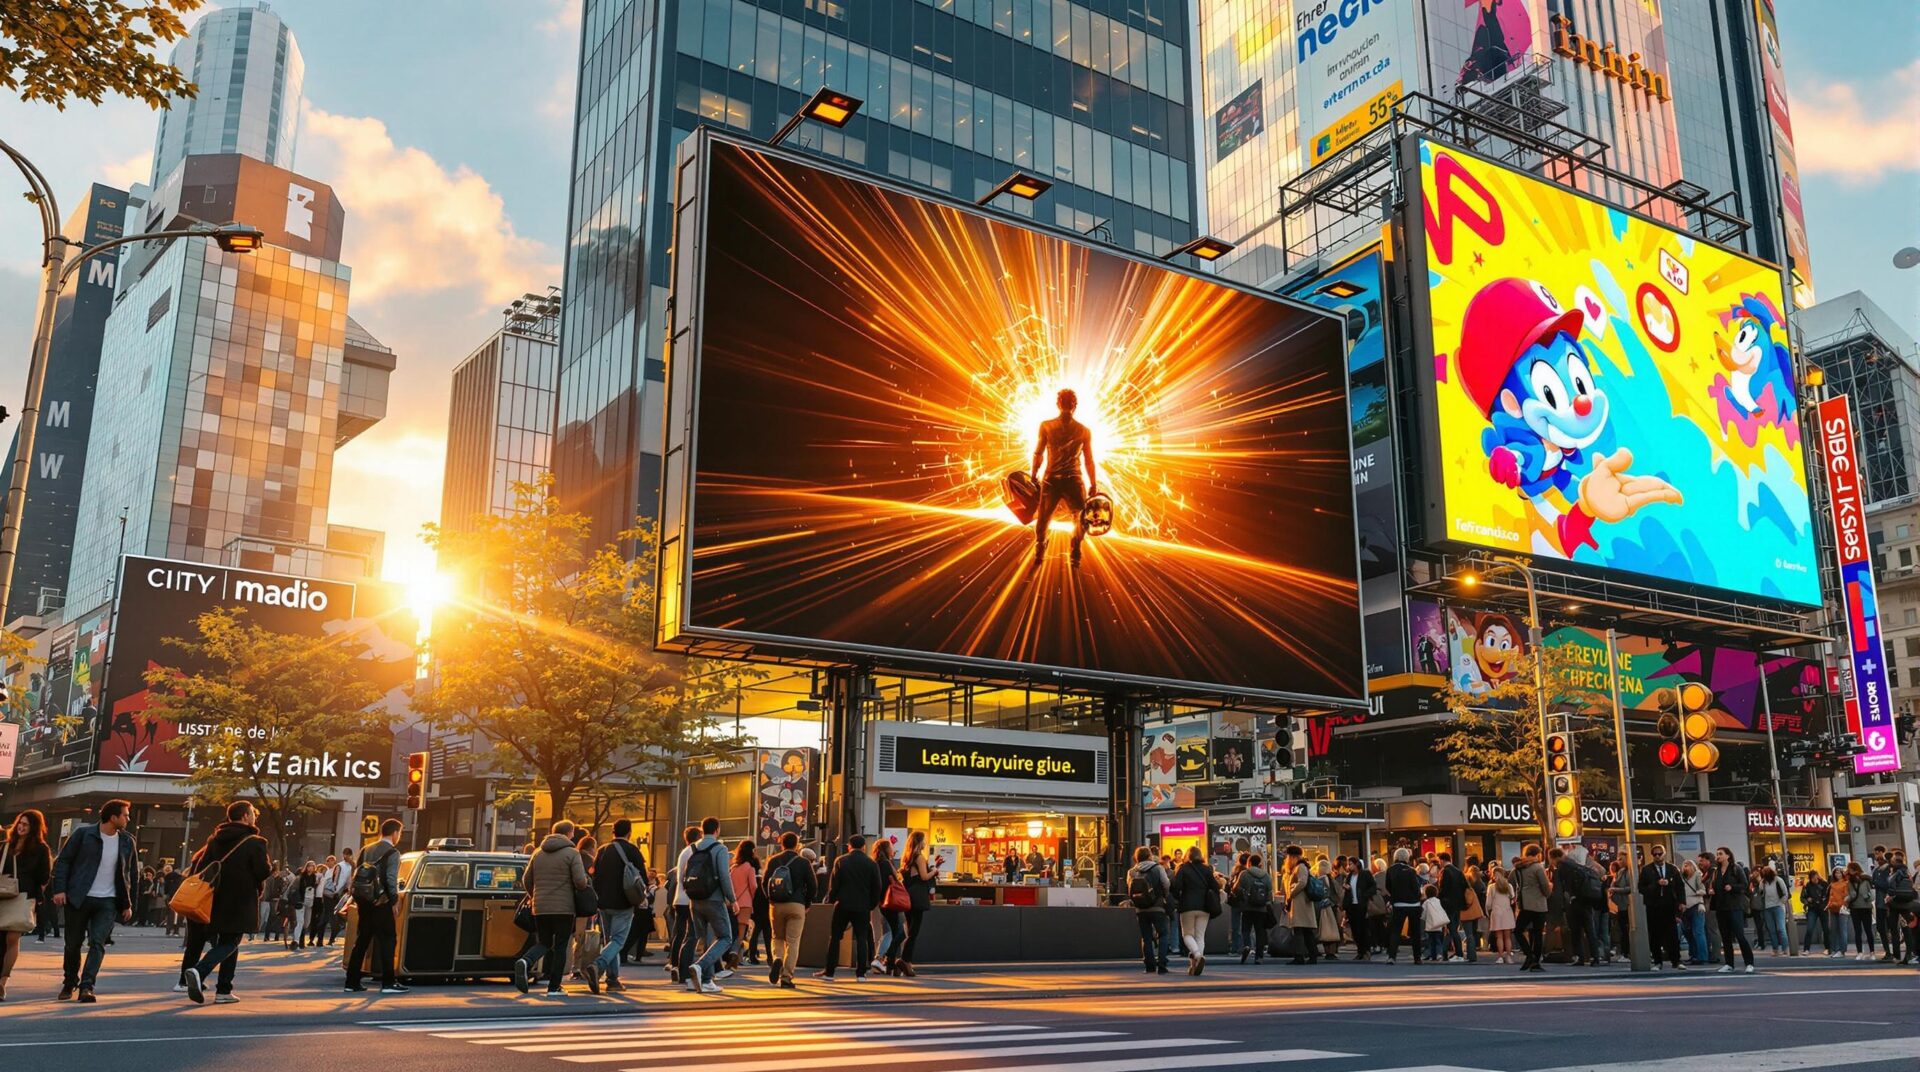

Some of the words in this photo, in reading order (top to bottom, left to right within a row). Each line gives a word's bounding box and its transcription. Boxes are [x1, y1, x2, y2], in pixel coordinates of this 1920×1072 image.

[88, 259, 115, 289] M
[46, 401, 70, 428] M
[40, 453, 64, 480] W
[234, 580, 328, 612] madio
[1469, 804, 1530, 820] ANDLUS
